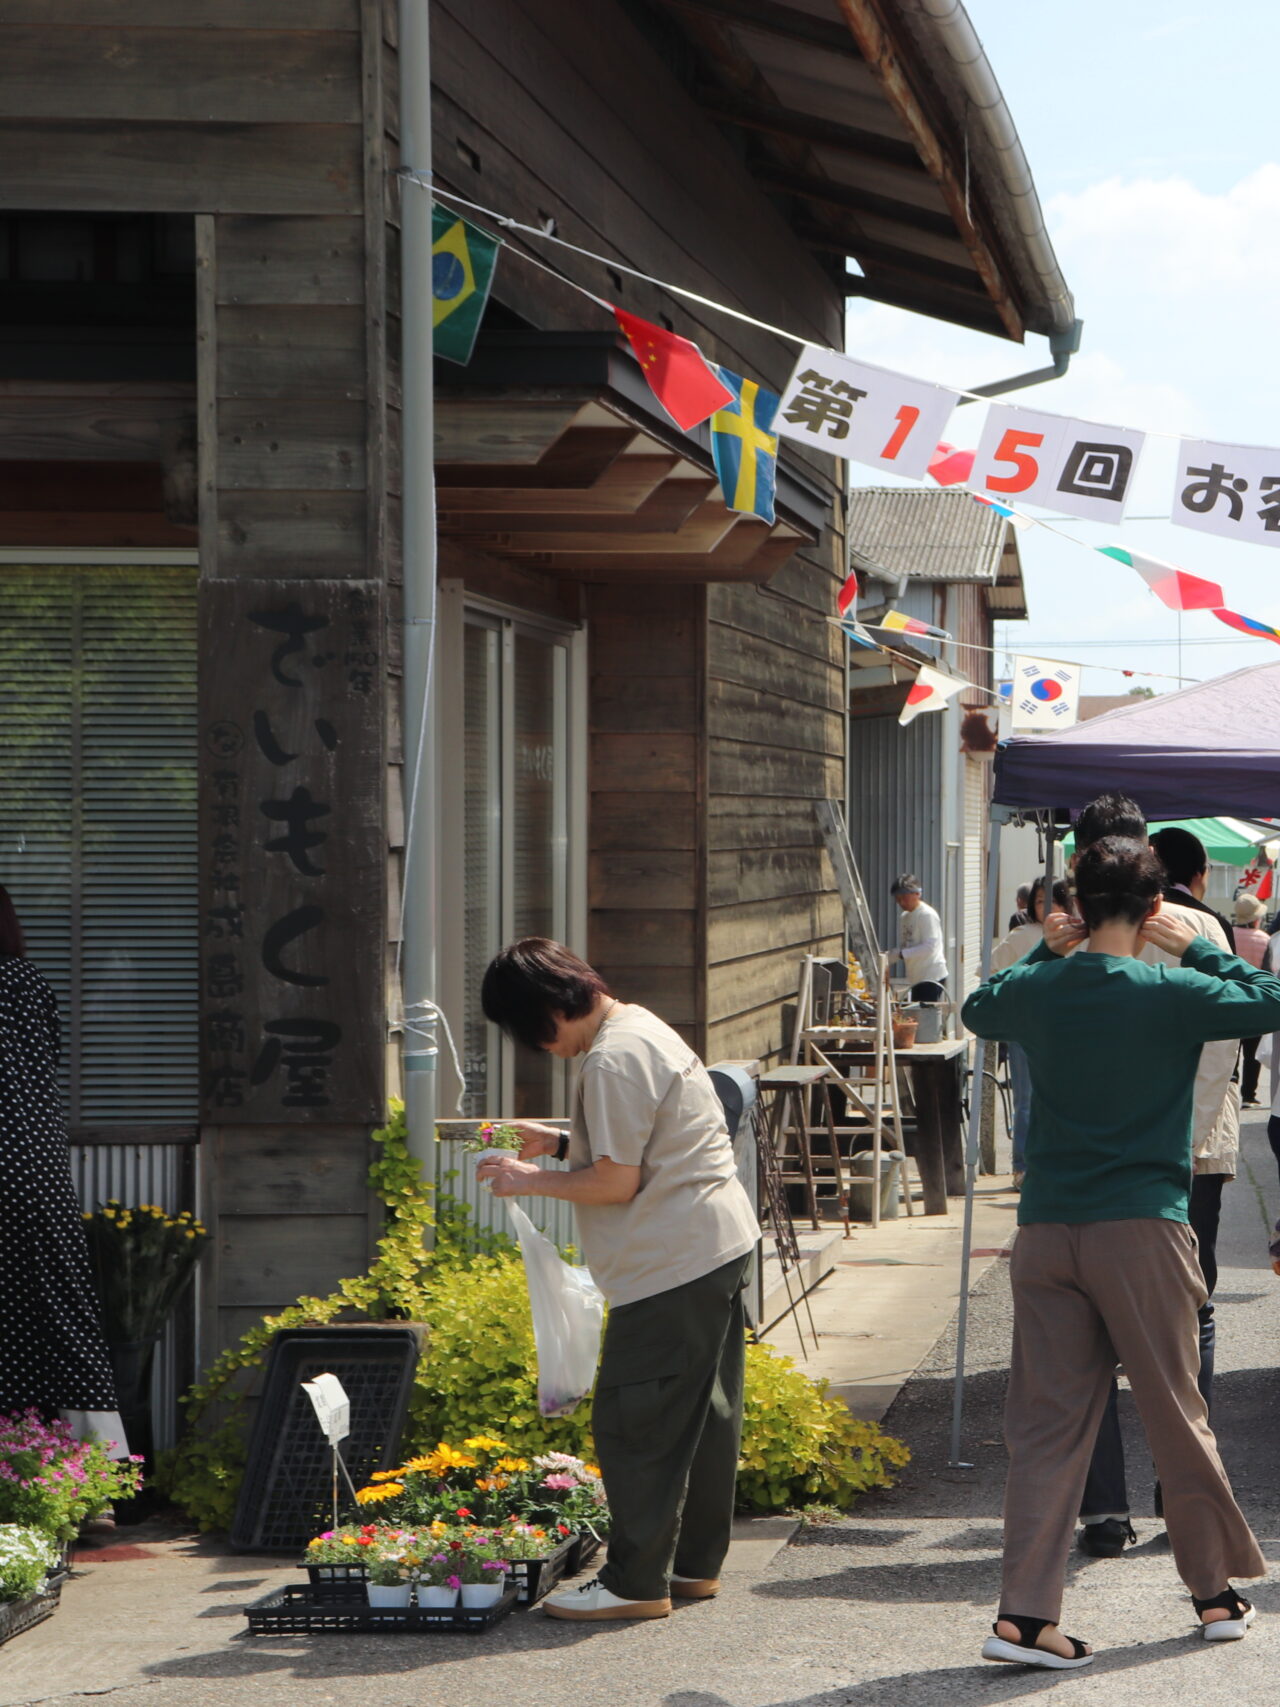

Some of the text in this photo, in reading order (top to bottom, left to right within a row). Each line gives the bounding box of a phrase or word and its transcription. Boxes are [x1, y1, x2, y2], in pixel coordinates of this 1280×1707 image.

[247, 602, 343, 1107] ざいもく屋
